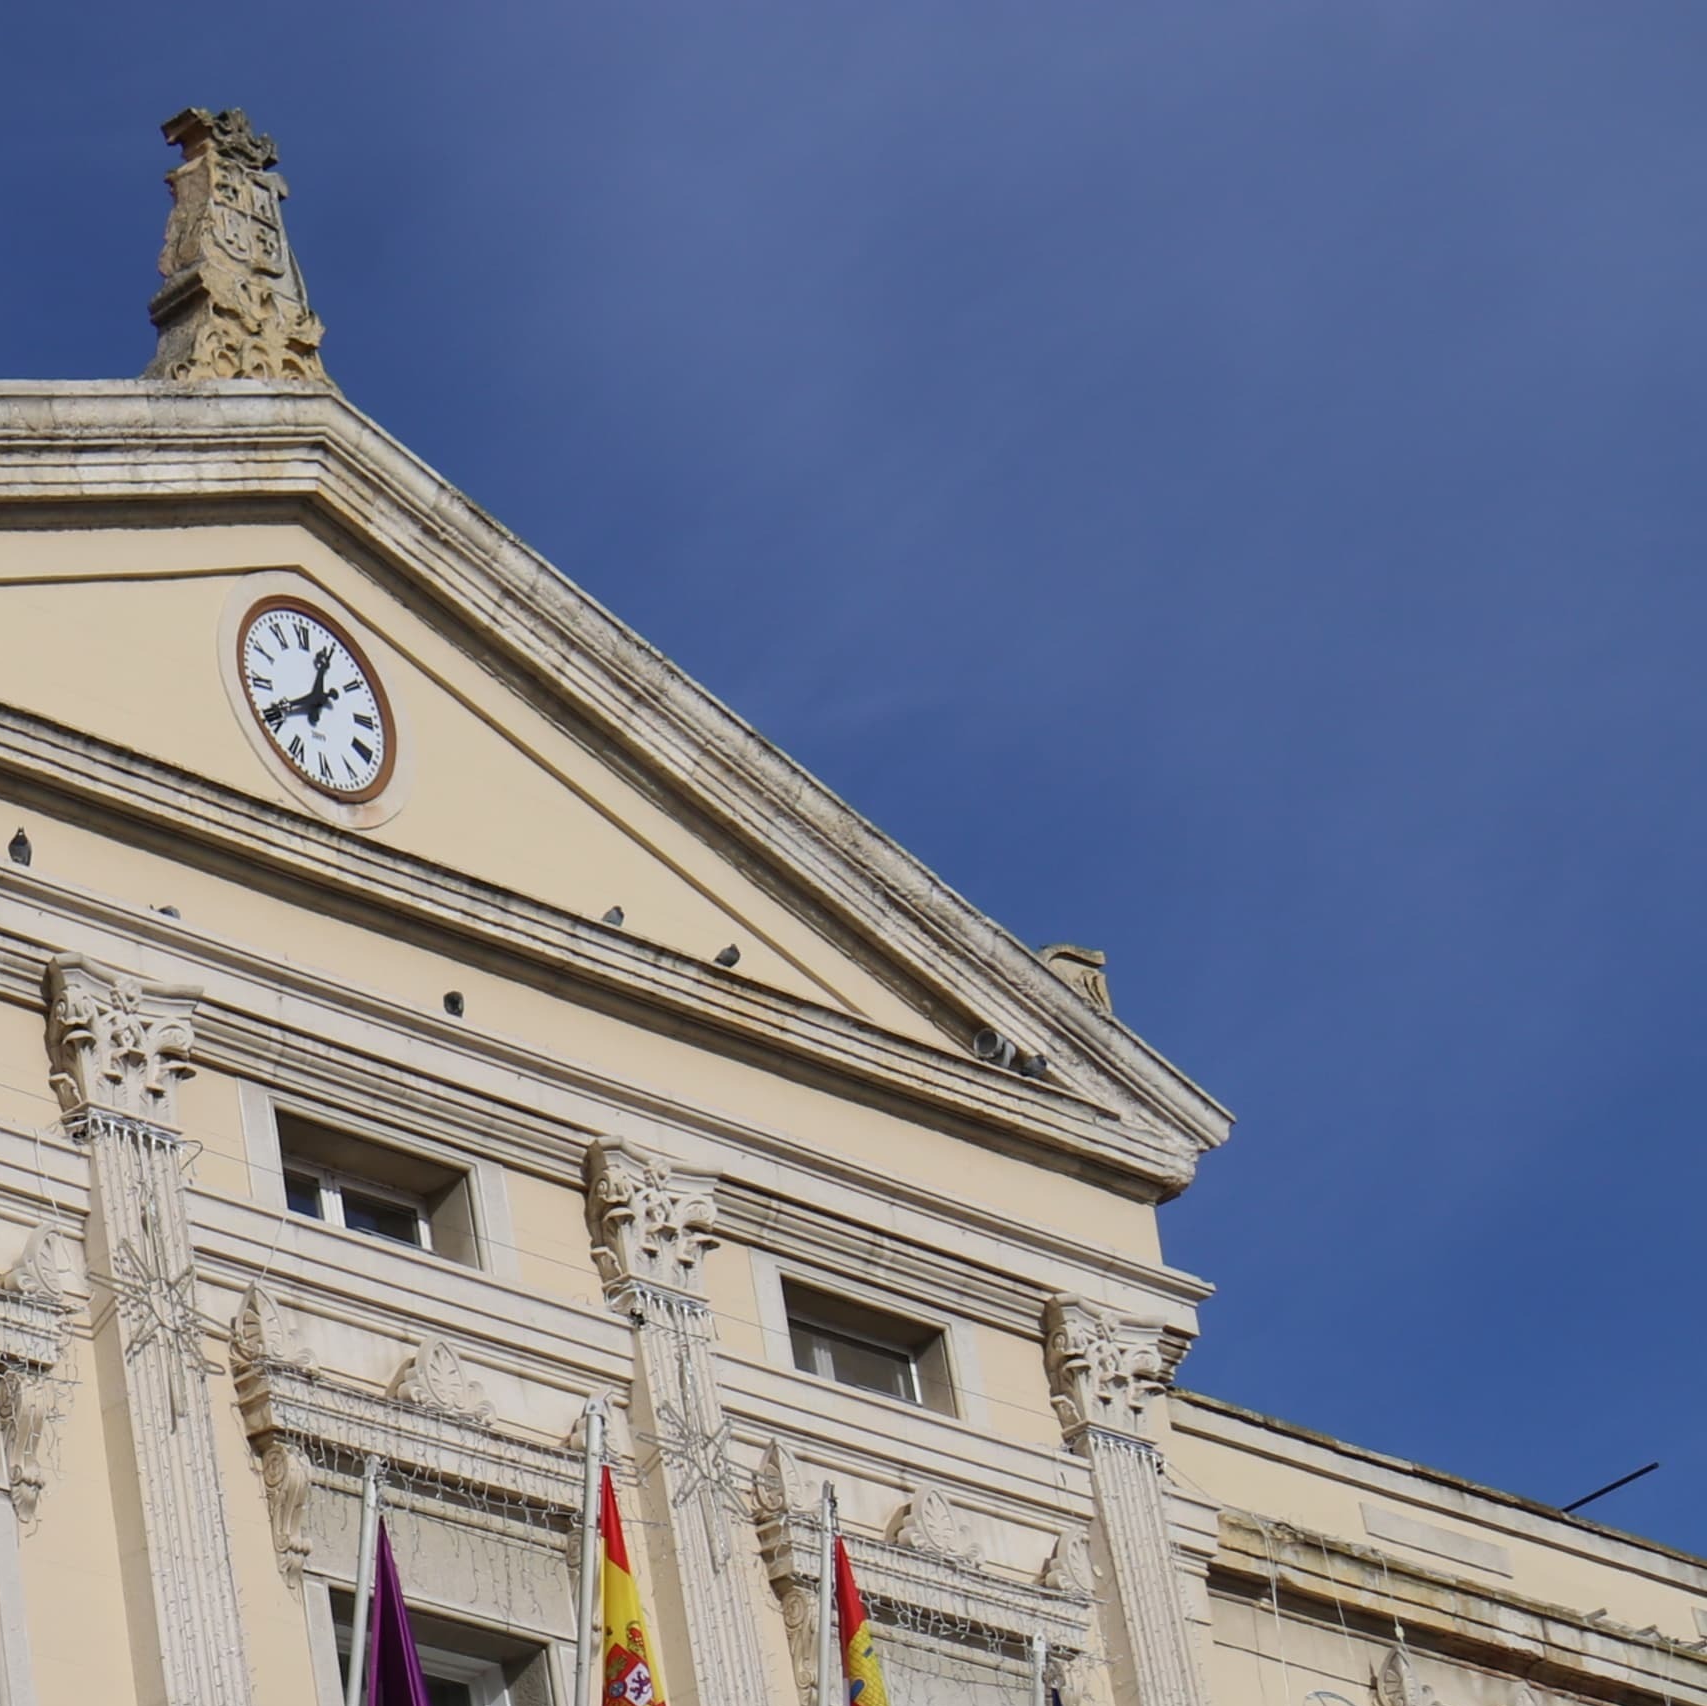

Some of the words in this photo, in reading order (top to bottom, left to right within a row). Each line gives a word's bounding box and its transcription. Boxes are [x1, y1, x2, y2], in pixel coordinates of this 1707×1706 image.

[293, 623, 310, 652] XII
[254, 640, 275, 666] X
[344, 680, 361, 693] II
[353, 713, 374, 730] III
